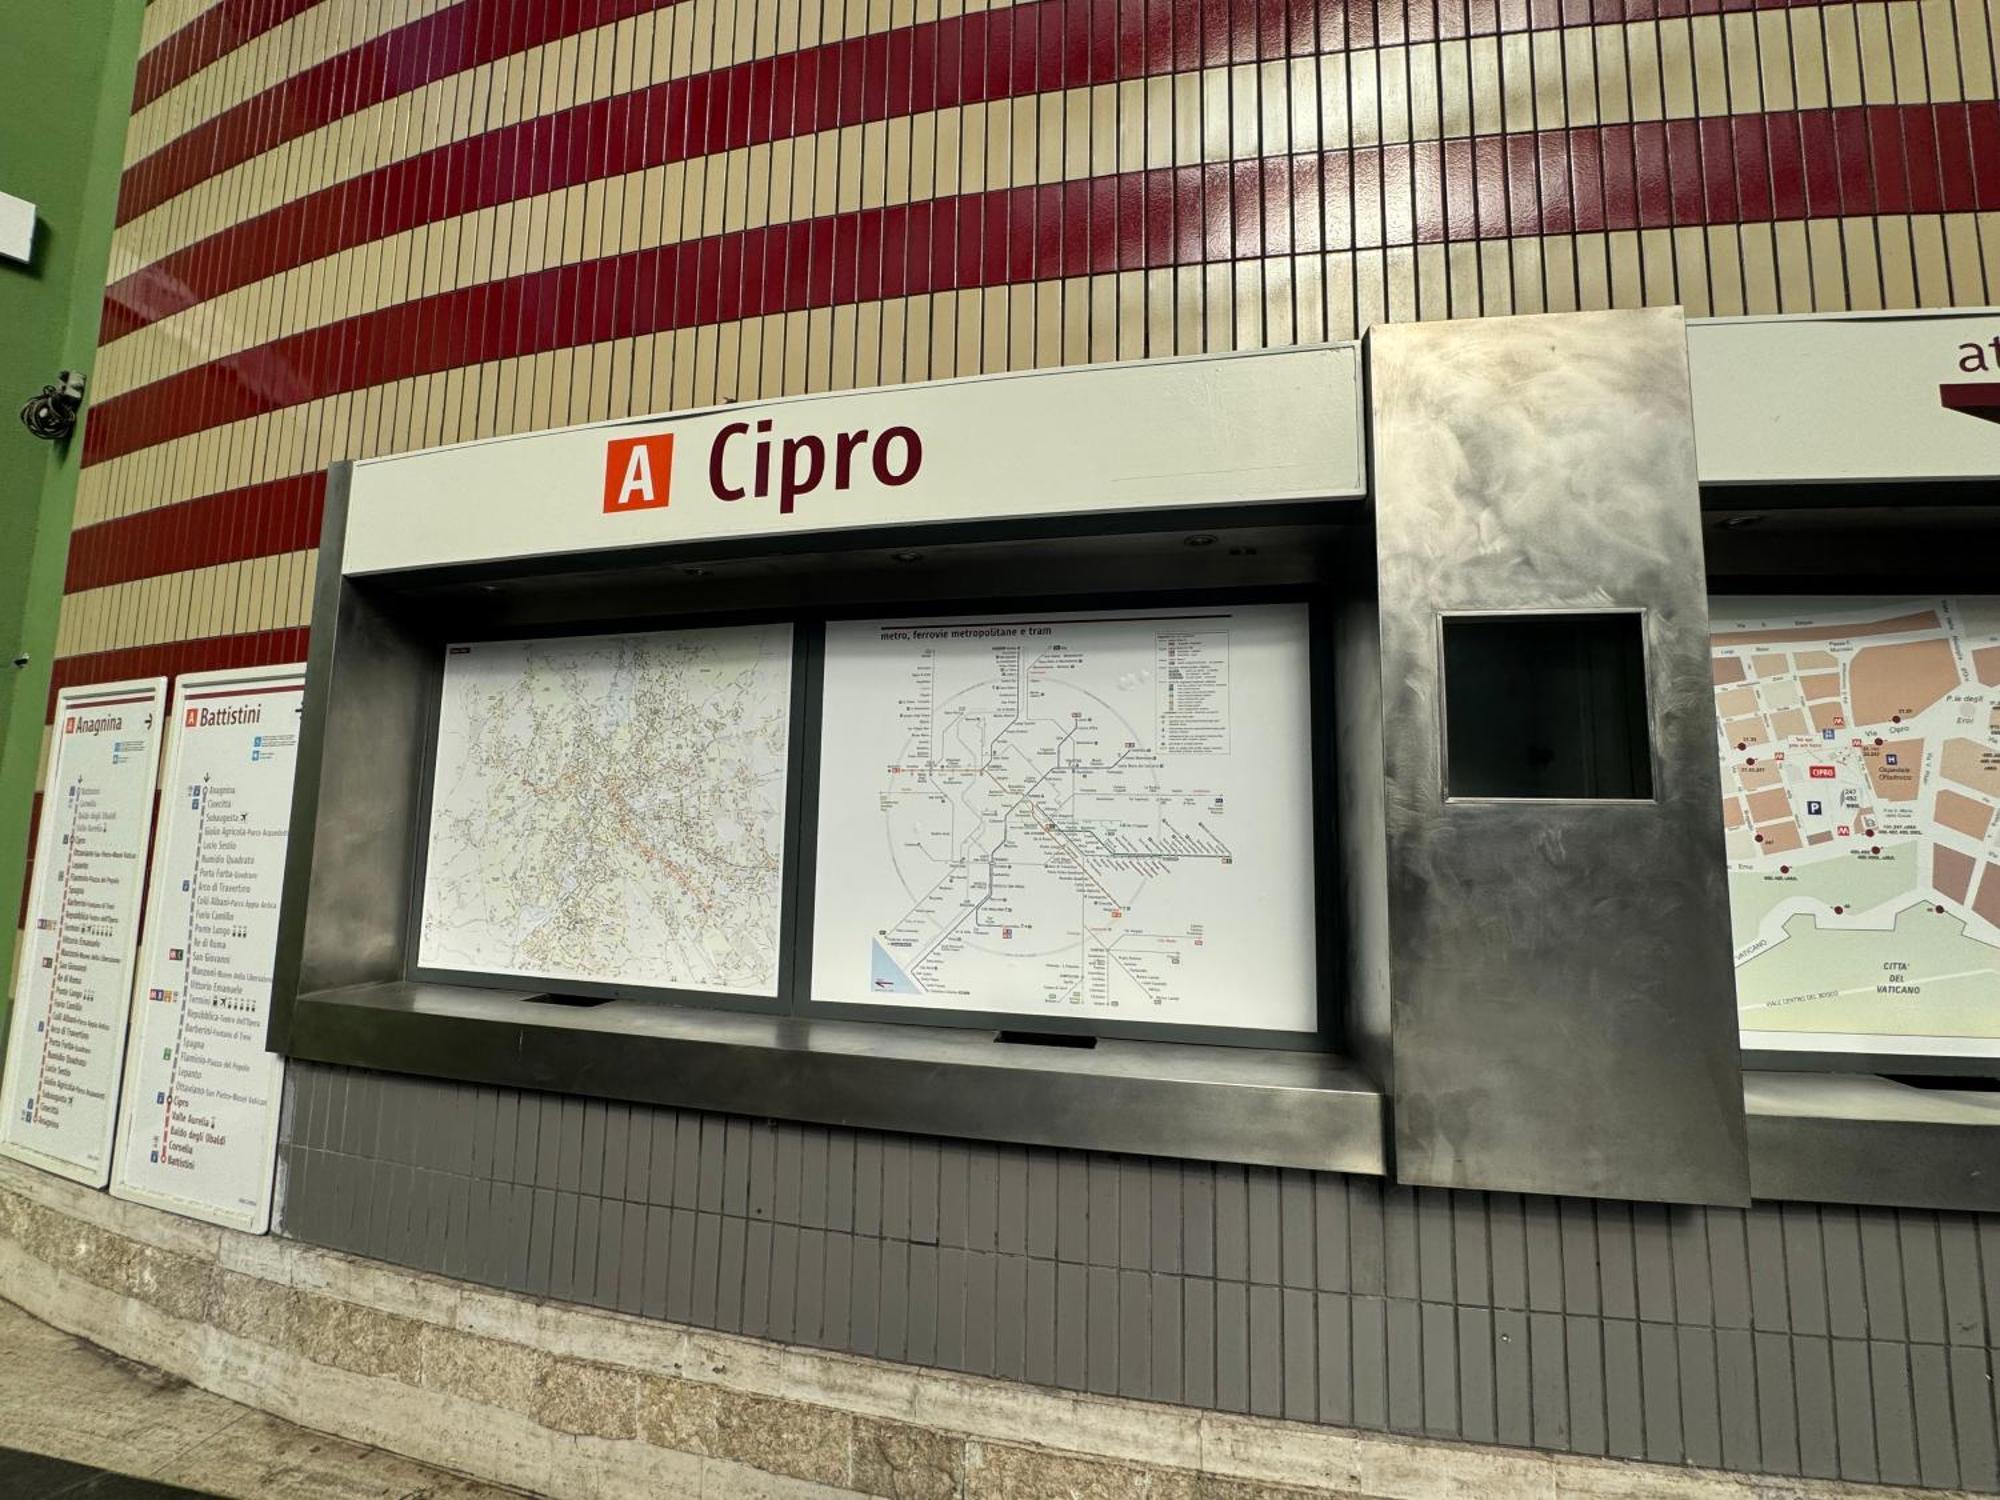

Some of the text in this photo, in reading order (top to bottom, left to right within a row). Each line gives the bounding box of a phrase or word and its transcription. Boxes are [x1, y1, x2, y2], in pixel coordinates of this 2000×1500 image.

[618, 419, 923, 514] A Cipro
[881, 631, 910, 641] metro,
[913, 629, 948, 639] ferrovie
[951, 628, 1017, 638] metropolitane
[1029, 626, 1052, 636] tram
[76, 714, 122, 736] Anagnina
[200, 703, 261, 727] Battistini
[1737, 939, 1767, 961] VATICANO
[1889, 974, 1904, 983] DEL
[1877, 986, 1920, 995] VATICANO
